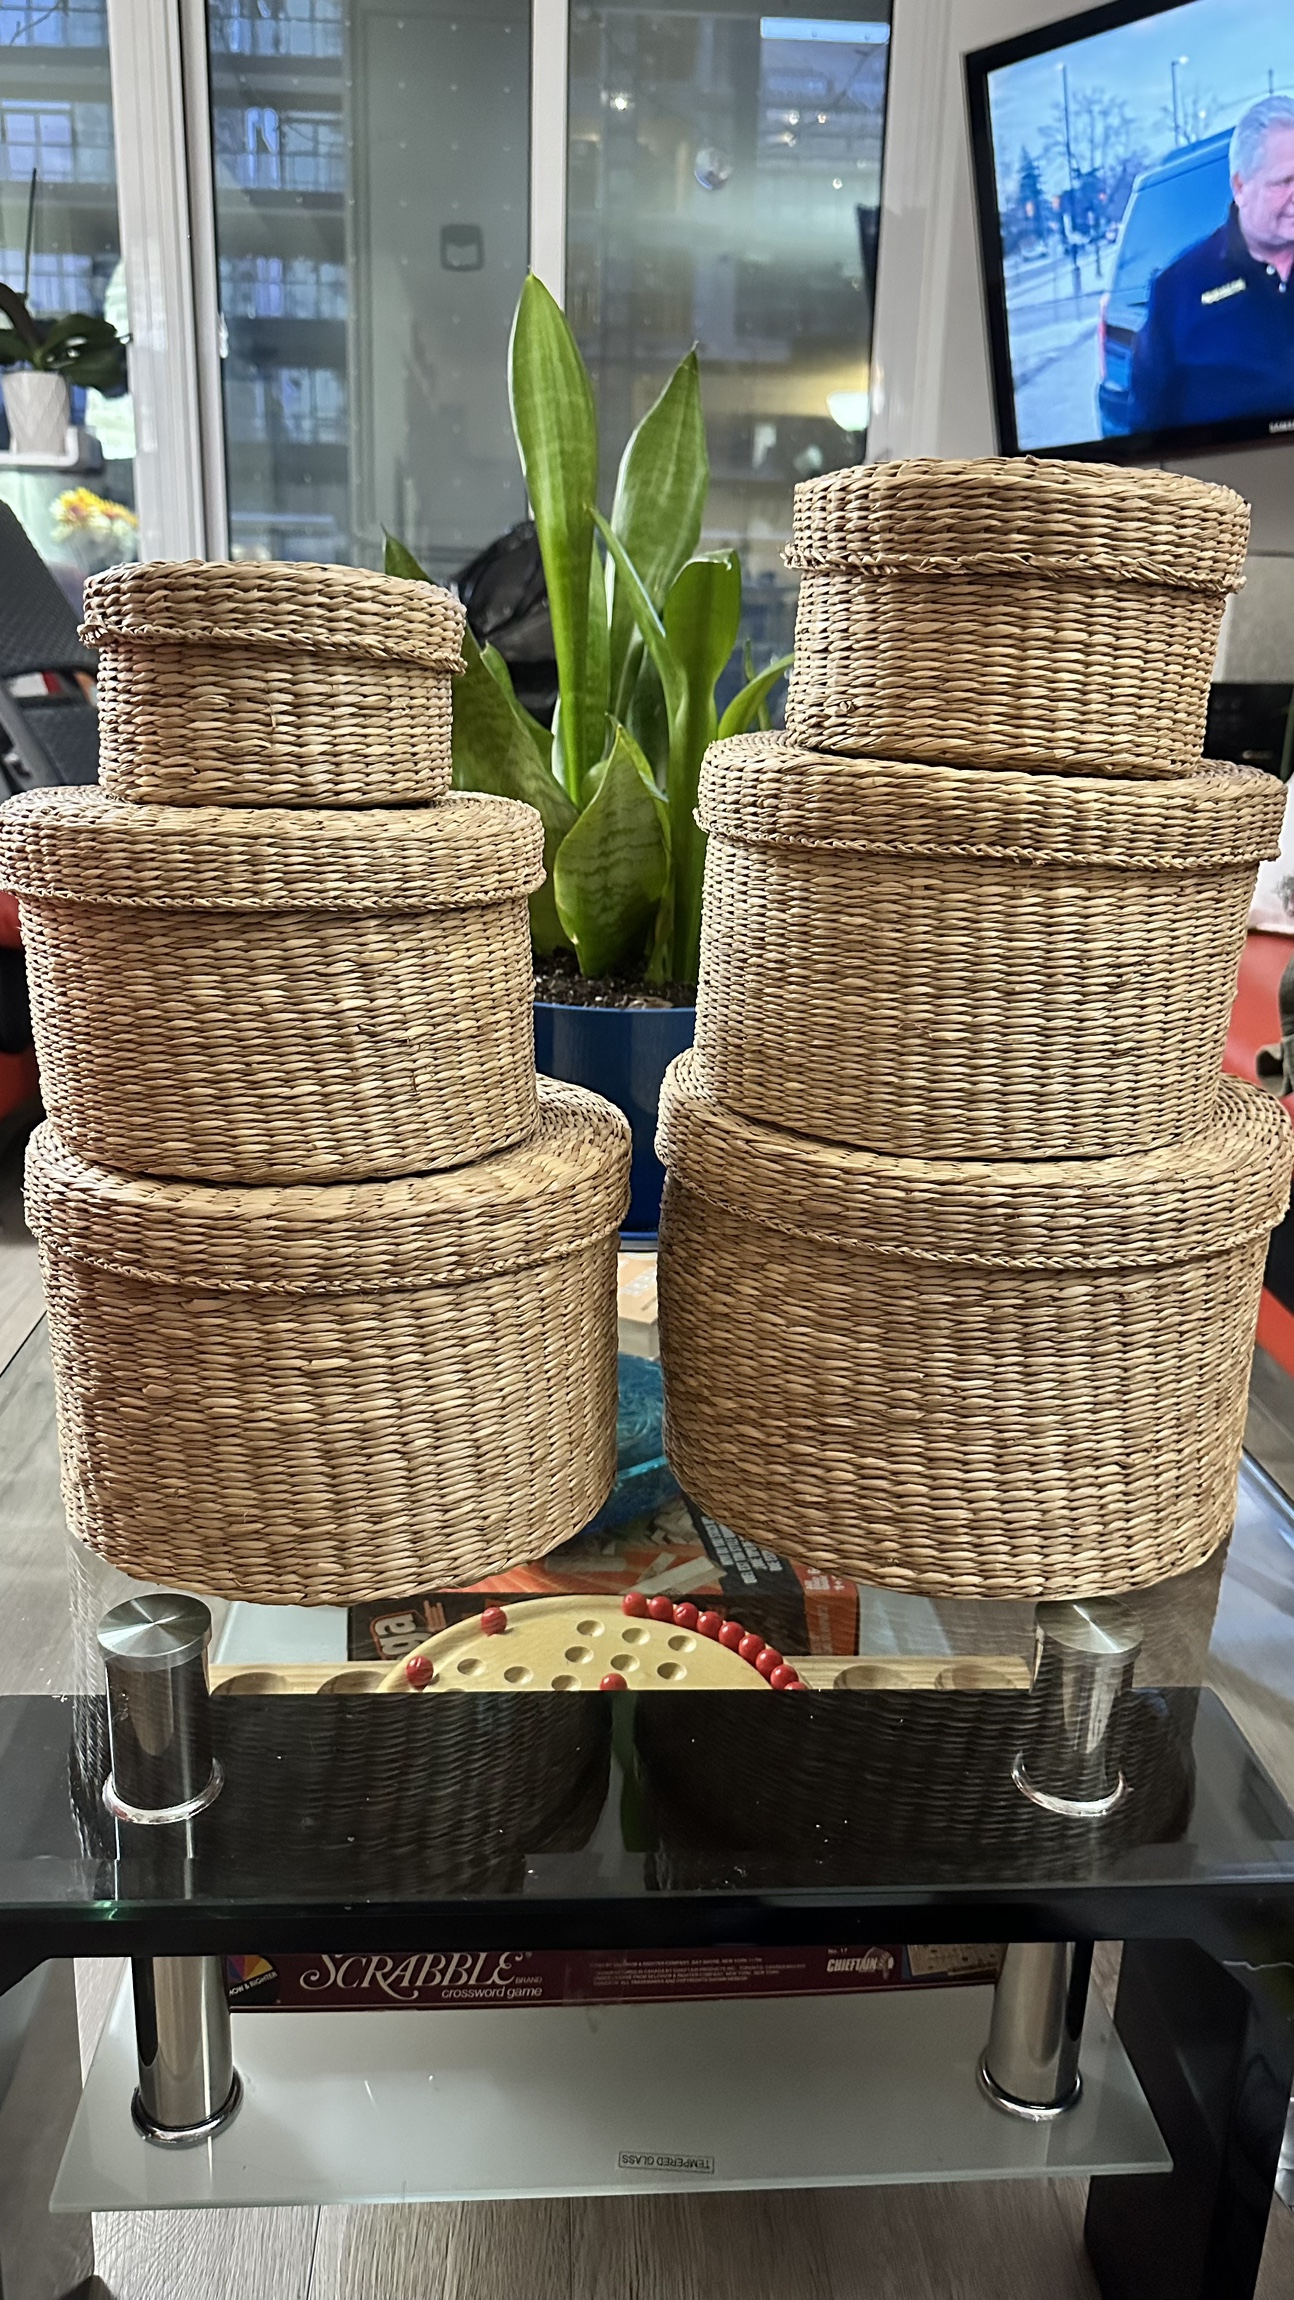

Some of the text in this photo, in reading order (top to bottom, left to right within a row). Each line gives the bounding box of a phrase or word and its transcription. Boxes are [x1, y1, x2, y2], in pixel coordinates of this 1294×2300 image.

[827, 1958, 878, 1972] CHIEFTAIN
[300, 1952, 523, 2000] SCRABBLE
[515, 1977, 543, 1985] BRAND
[441, 1986, 542, 1999] crossword game
[622, 2155, 709, 2169] TEMPERED GLASS
